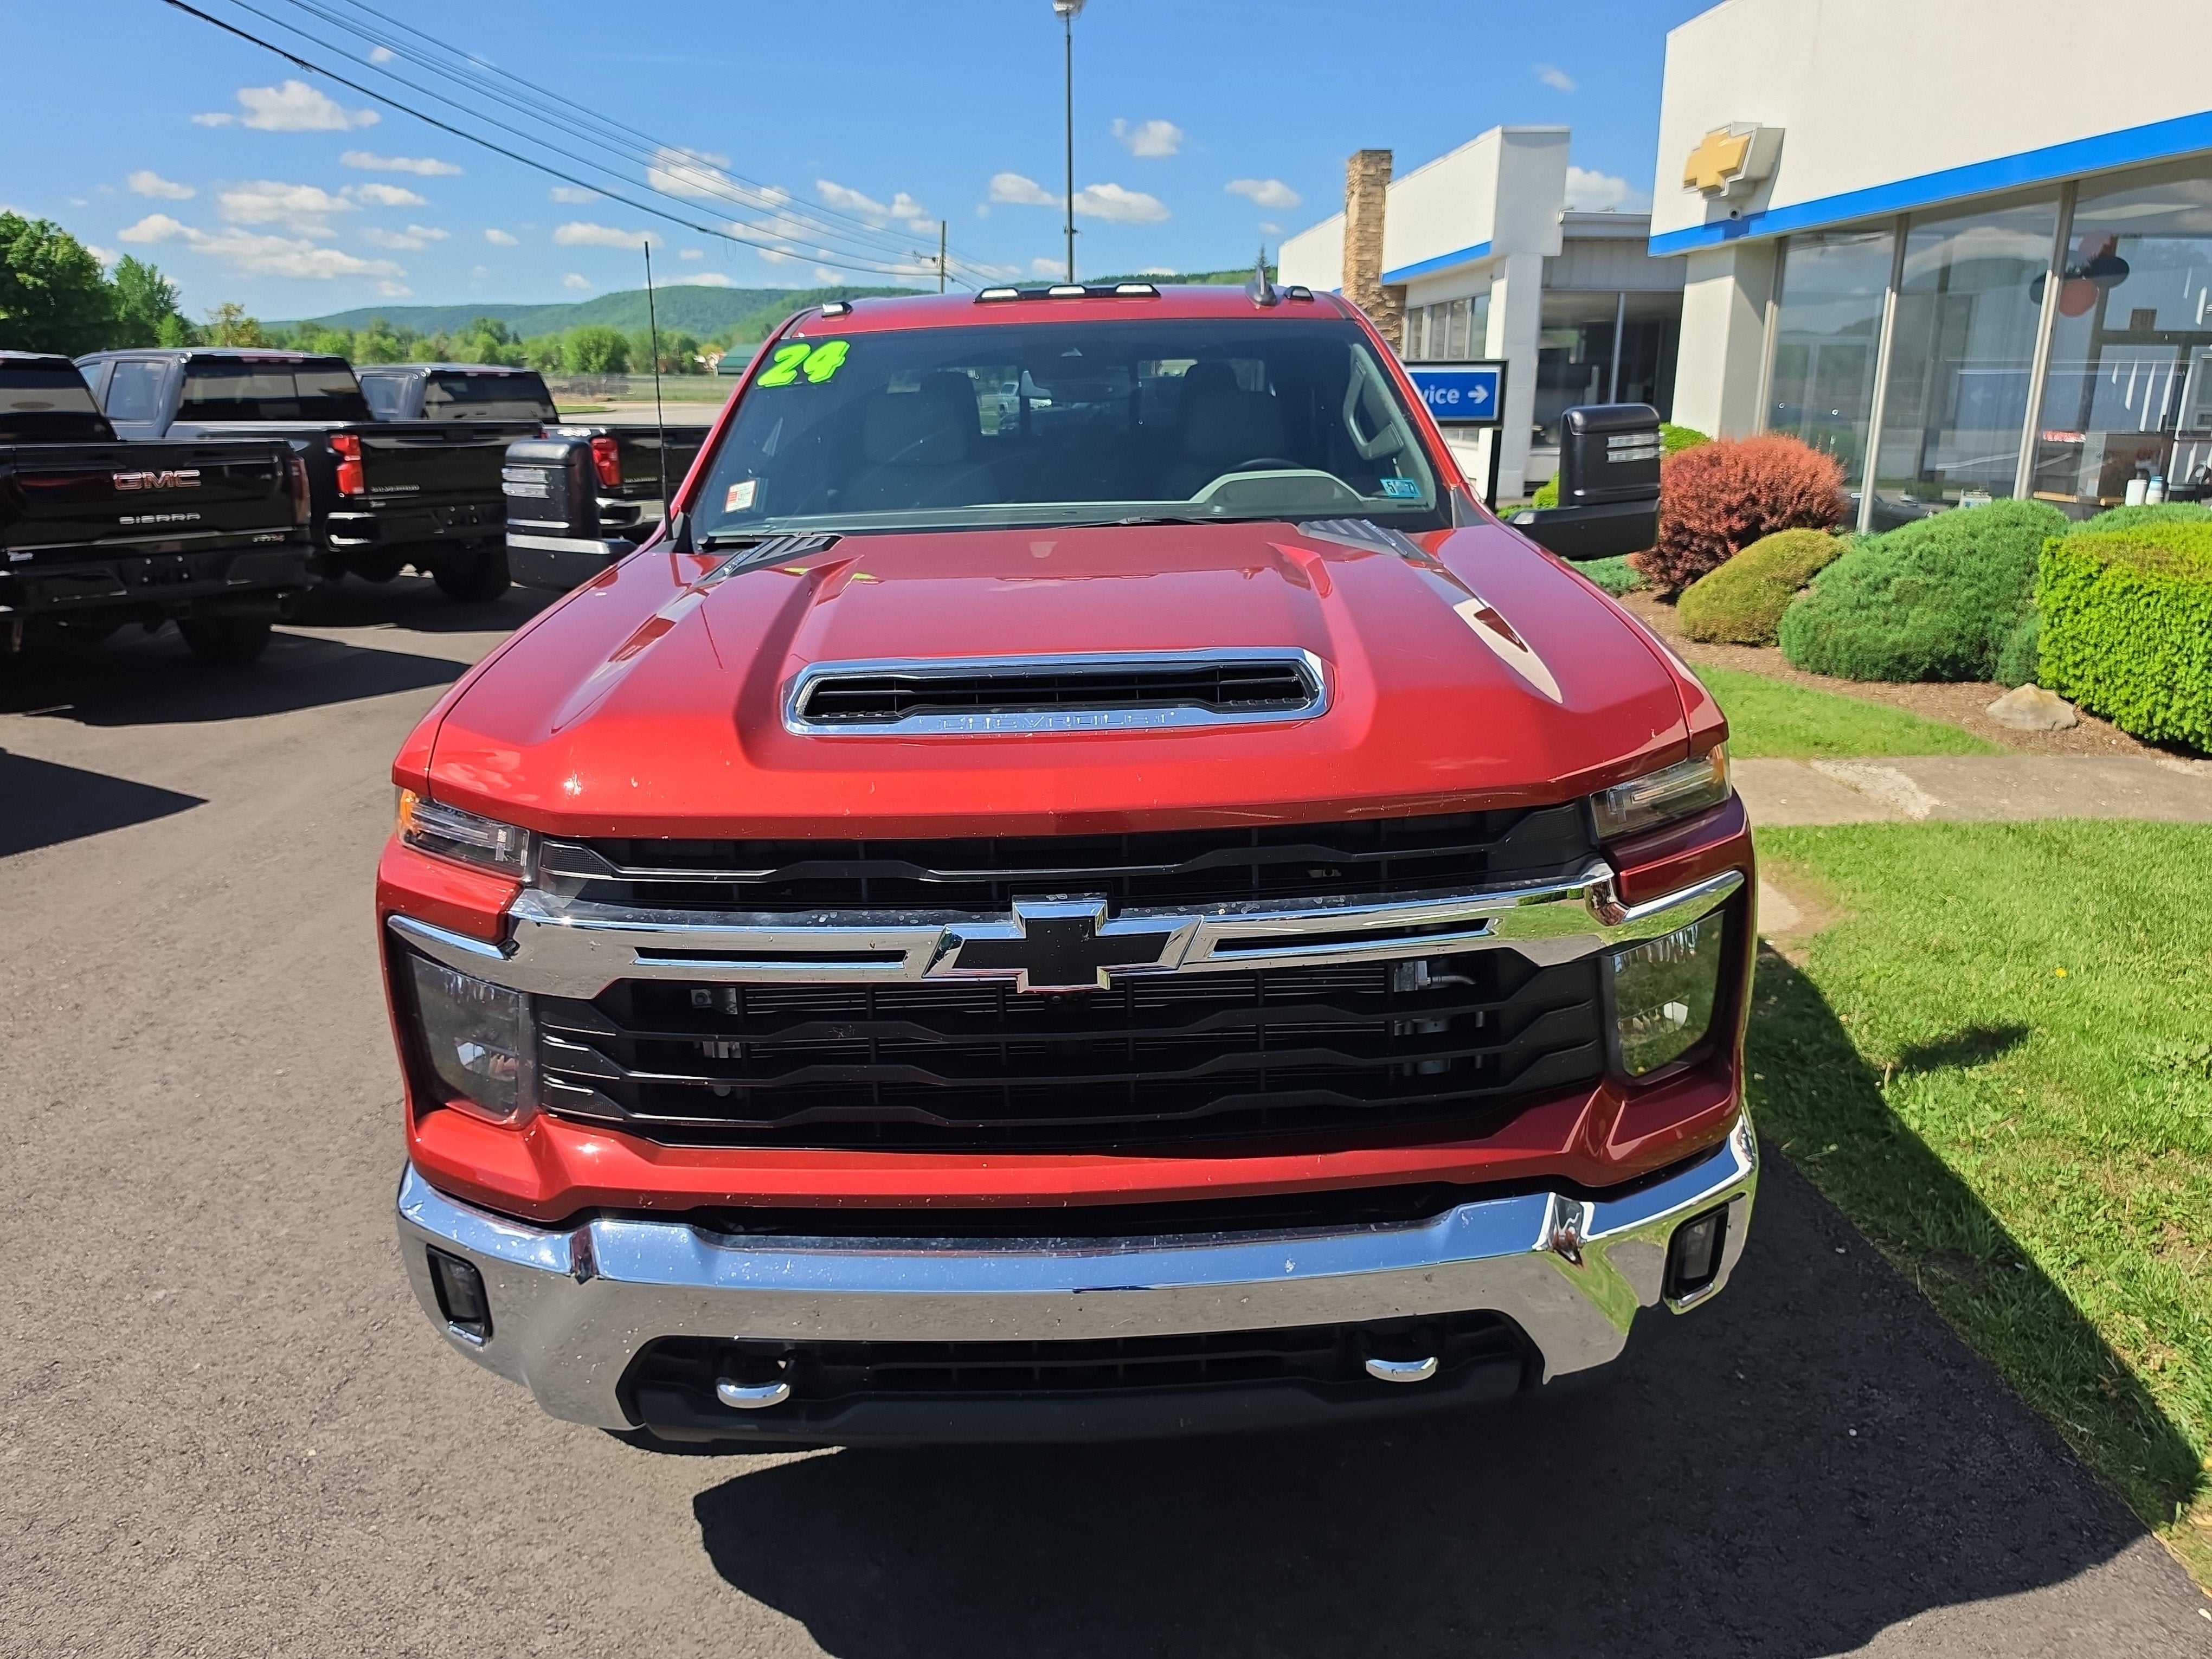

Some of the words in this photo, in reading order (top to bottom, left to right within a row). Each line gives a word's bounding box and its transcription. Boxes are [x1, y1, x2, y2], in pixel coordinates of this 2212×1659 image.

[757, 339, 851, 387] 24
[113, 470, 202, 490] GMC
[119, 512, 201, 525] SIERRA
